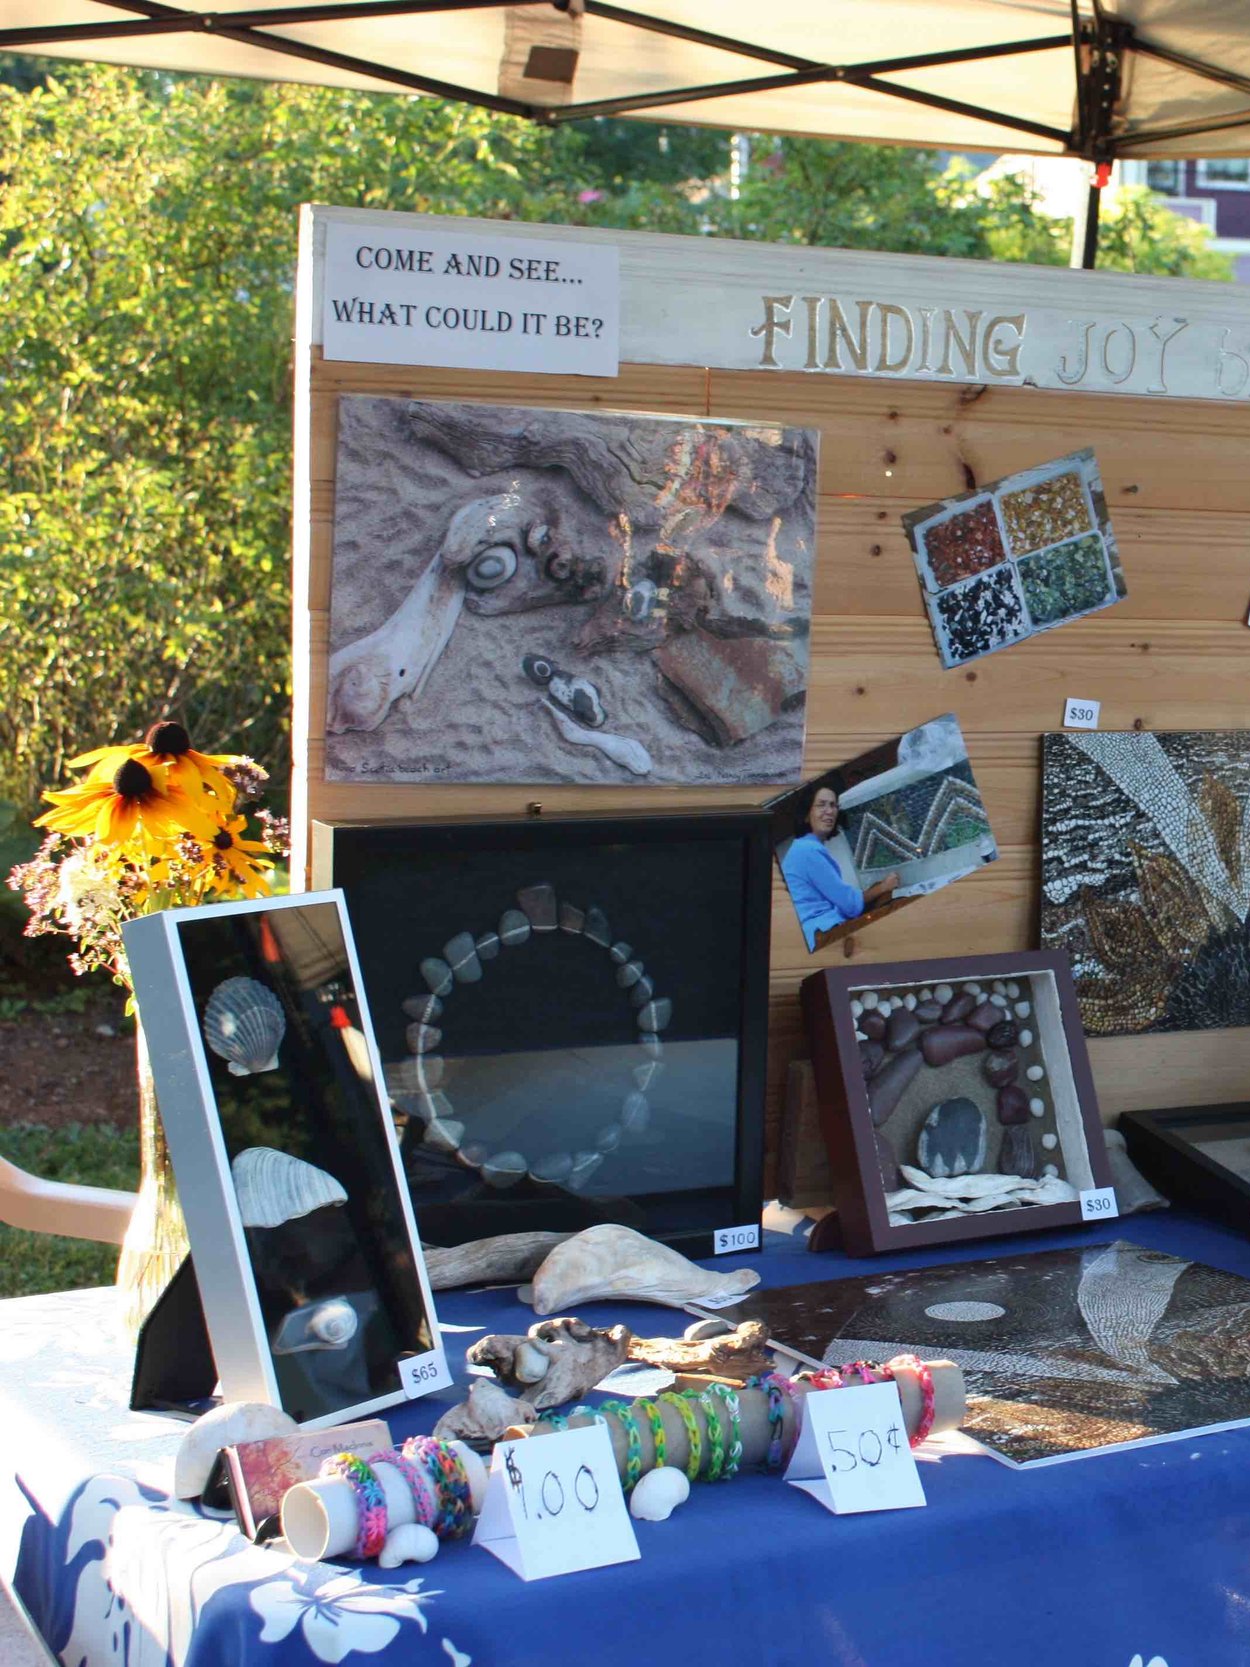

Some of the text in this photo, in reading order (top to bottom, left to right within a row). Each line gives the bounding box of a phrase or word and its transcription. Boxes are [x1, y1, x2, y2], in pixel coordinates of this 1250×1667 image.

[356, 246, 583, 285] COME AND SEE...
[332, 297, 604, 339] WHAT COULD IT BE?
[749, 294, 1027, 379] FINDING
[1053, 315, 1190, 394] JOY
[1070, 707, 1094, 721] $30
[1086, 1197, 1111, 1212] $30
[719, 1231, 756, 1248] $100
[411, 1361, 438, 1384] $65
